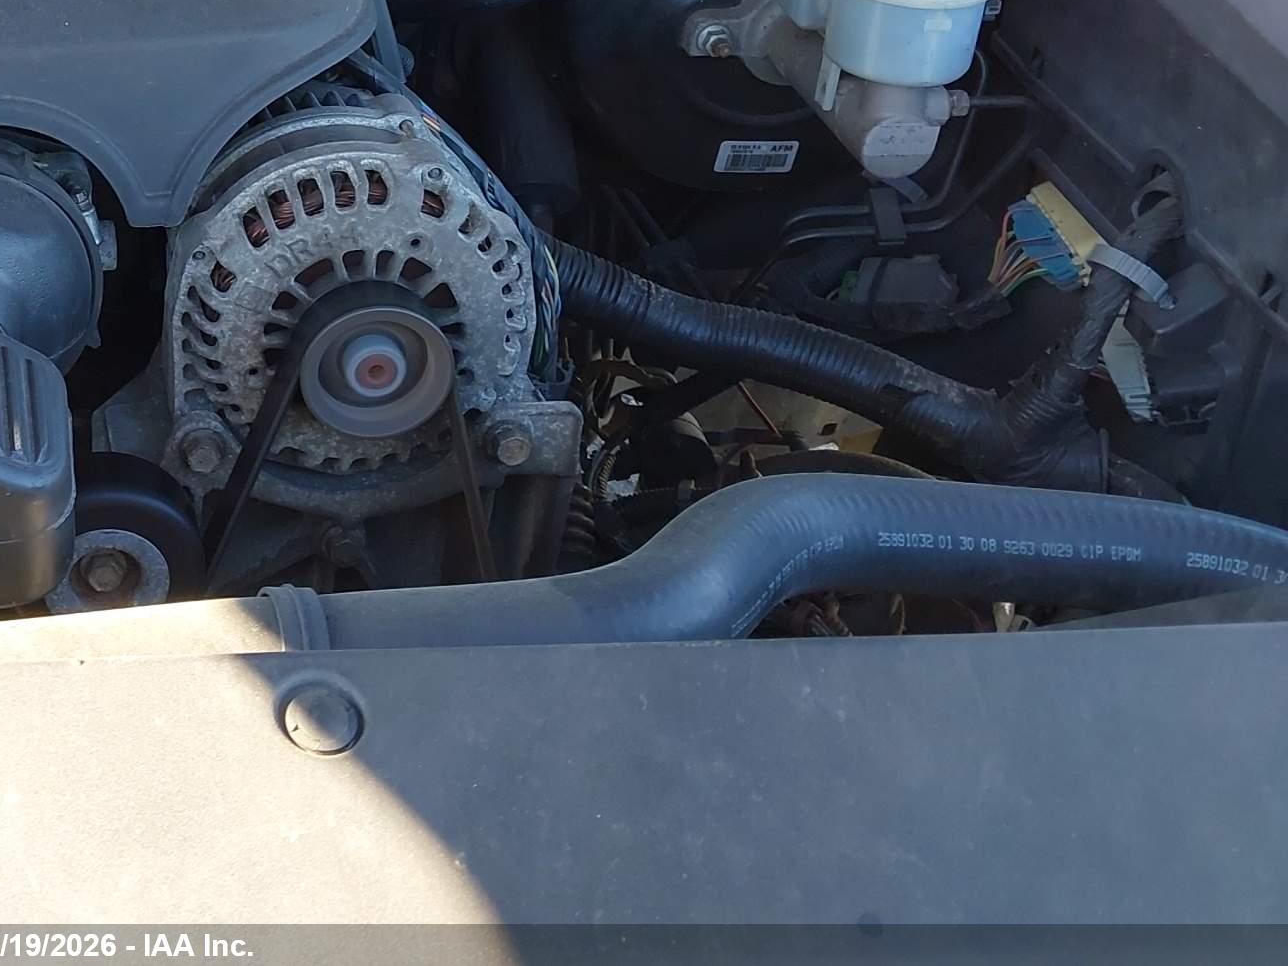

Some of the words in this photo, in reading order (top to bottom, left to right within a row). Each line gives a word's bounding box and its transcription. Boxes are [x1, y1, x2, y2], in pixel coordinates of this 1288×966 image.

[770, 144, 794, 152] AFM
[877, 532, 935, 548] 25891032
[938, 535, 952, 549] 01
[959, 536, 975, 551] 30
[980, 538, 997, 552] 08
[1111, 546, 1142, 562] EPDM
